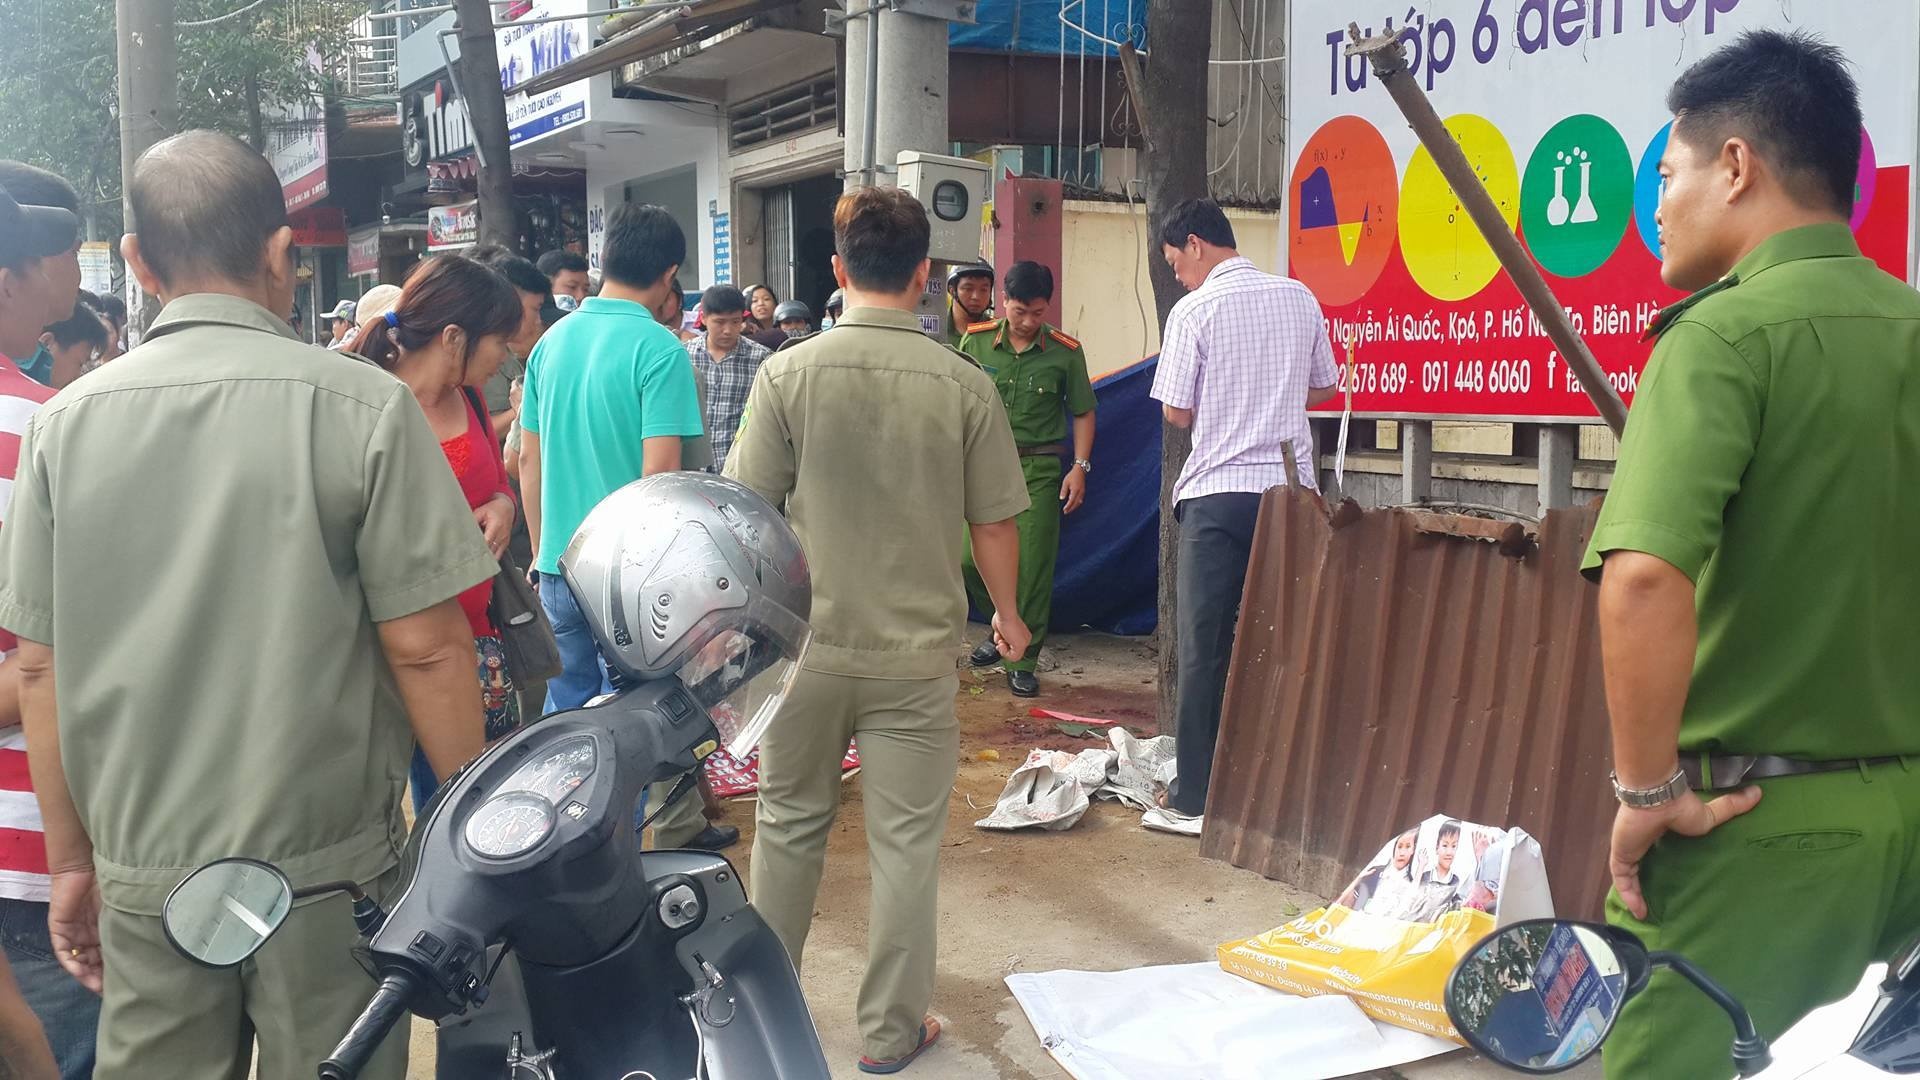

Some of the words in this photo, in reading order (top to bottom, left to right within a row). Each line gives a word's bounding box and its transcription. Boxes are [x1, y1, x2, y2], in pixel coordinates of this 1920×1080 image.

[1472, 0, 1499, 64] 6
[1385, 307, 1400, 341] Ái
[1402, 309, 1445, 344] Quốc,
[1449, 310, 1480, 345] Kp6,
[1484, 310, 1498, 338] P.
[1502, 304, 1525, 338] Hố
[1593, 304, 1630, 335] Biên
[1422, 360, 1449, 394] 091
[1454, 359, 1484, 394] 448
[1488, 359, 1531, 394] 6060
